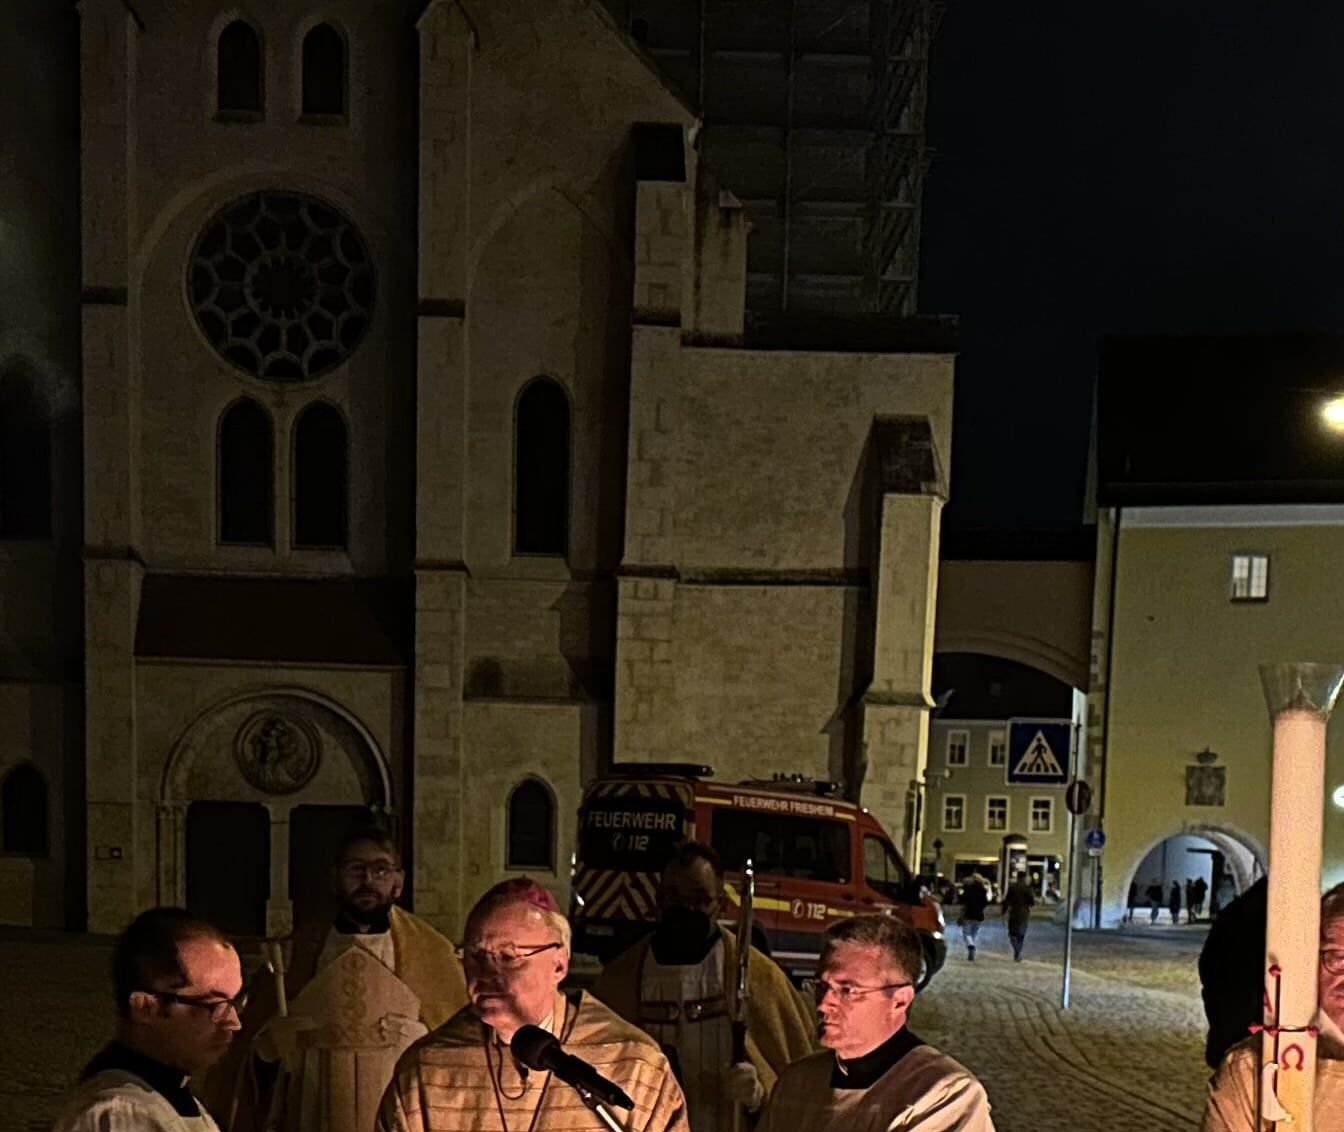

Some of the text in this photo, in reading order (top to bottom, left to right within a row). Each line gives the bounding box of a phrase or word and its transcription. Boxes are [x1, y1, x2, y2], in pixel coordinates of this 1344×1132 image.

[733, 795, 789, 812] FEUERWEHR
[587, 810, 677, 831] FEUERWEHR
[628, 834, 650, 852] 112
[807, 902, 826, 920] 112
[1280, 1042, 1305, 1071] Ω
